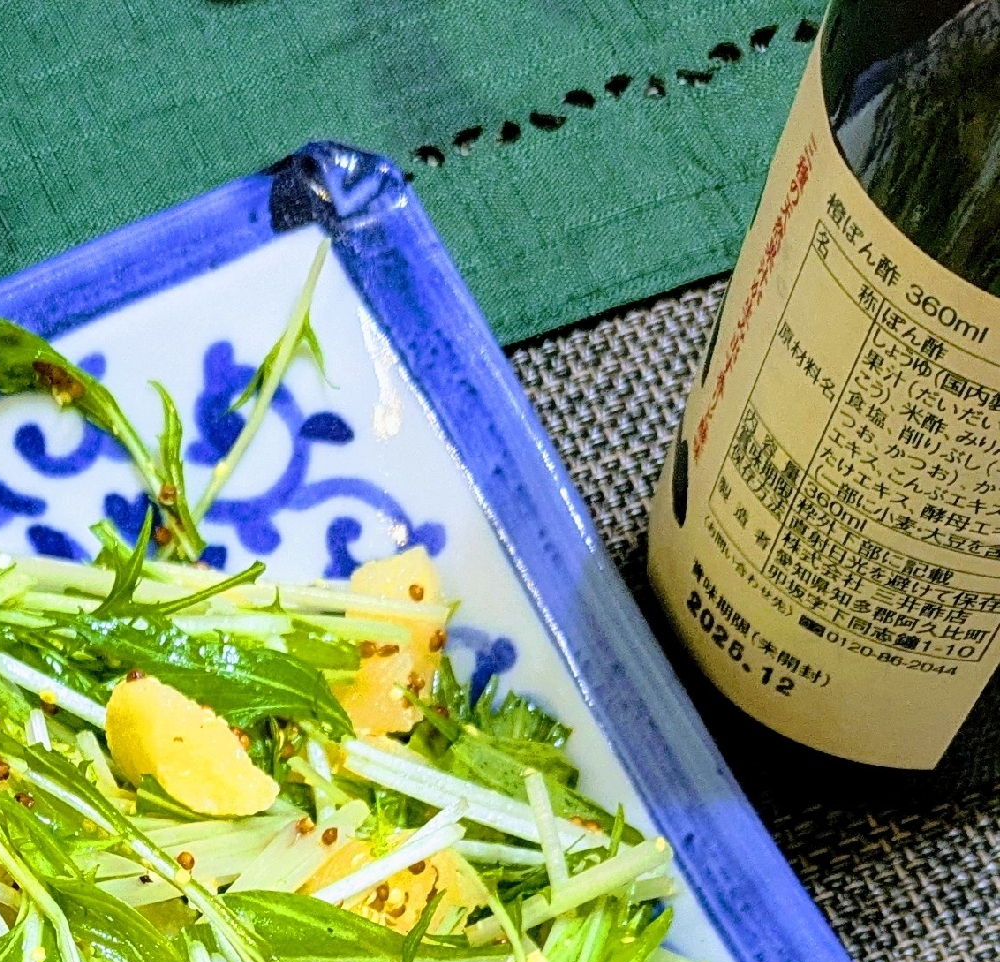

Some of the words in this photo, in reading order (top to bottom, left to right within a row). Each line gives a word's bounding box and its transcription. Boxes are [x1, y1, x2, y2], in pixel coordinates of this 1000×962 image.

[827, 193, 901, 287] 橙ぽん酢
[905, 283, 989, 344] 360ml
[777, 321, 835, 403] 原材料名
[881, 306, 949, 360] ぽん酢
[854, 370, 1000, 456] こう）、米酢、みり
[804, 481, 868, 532] 360ml
[776, 549, 990, 644] 愛知県知多郡阿久比町
[782, 531, 863, 594] 株式会社
[870, 586, 973, 624] 三井酢店
